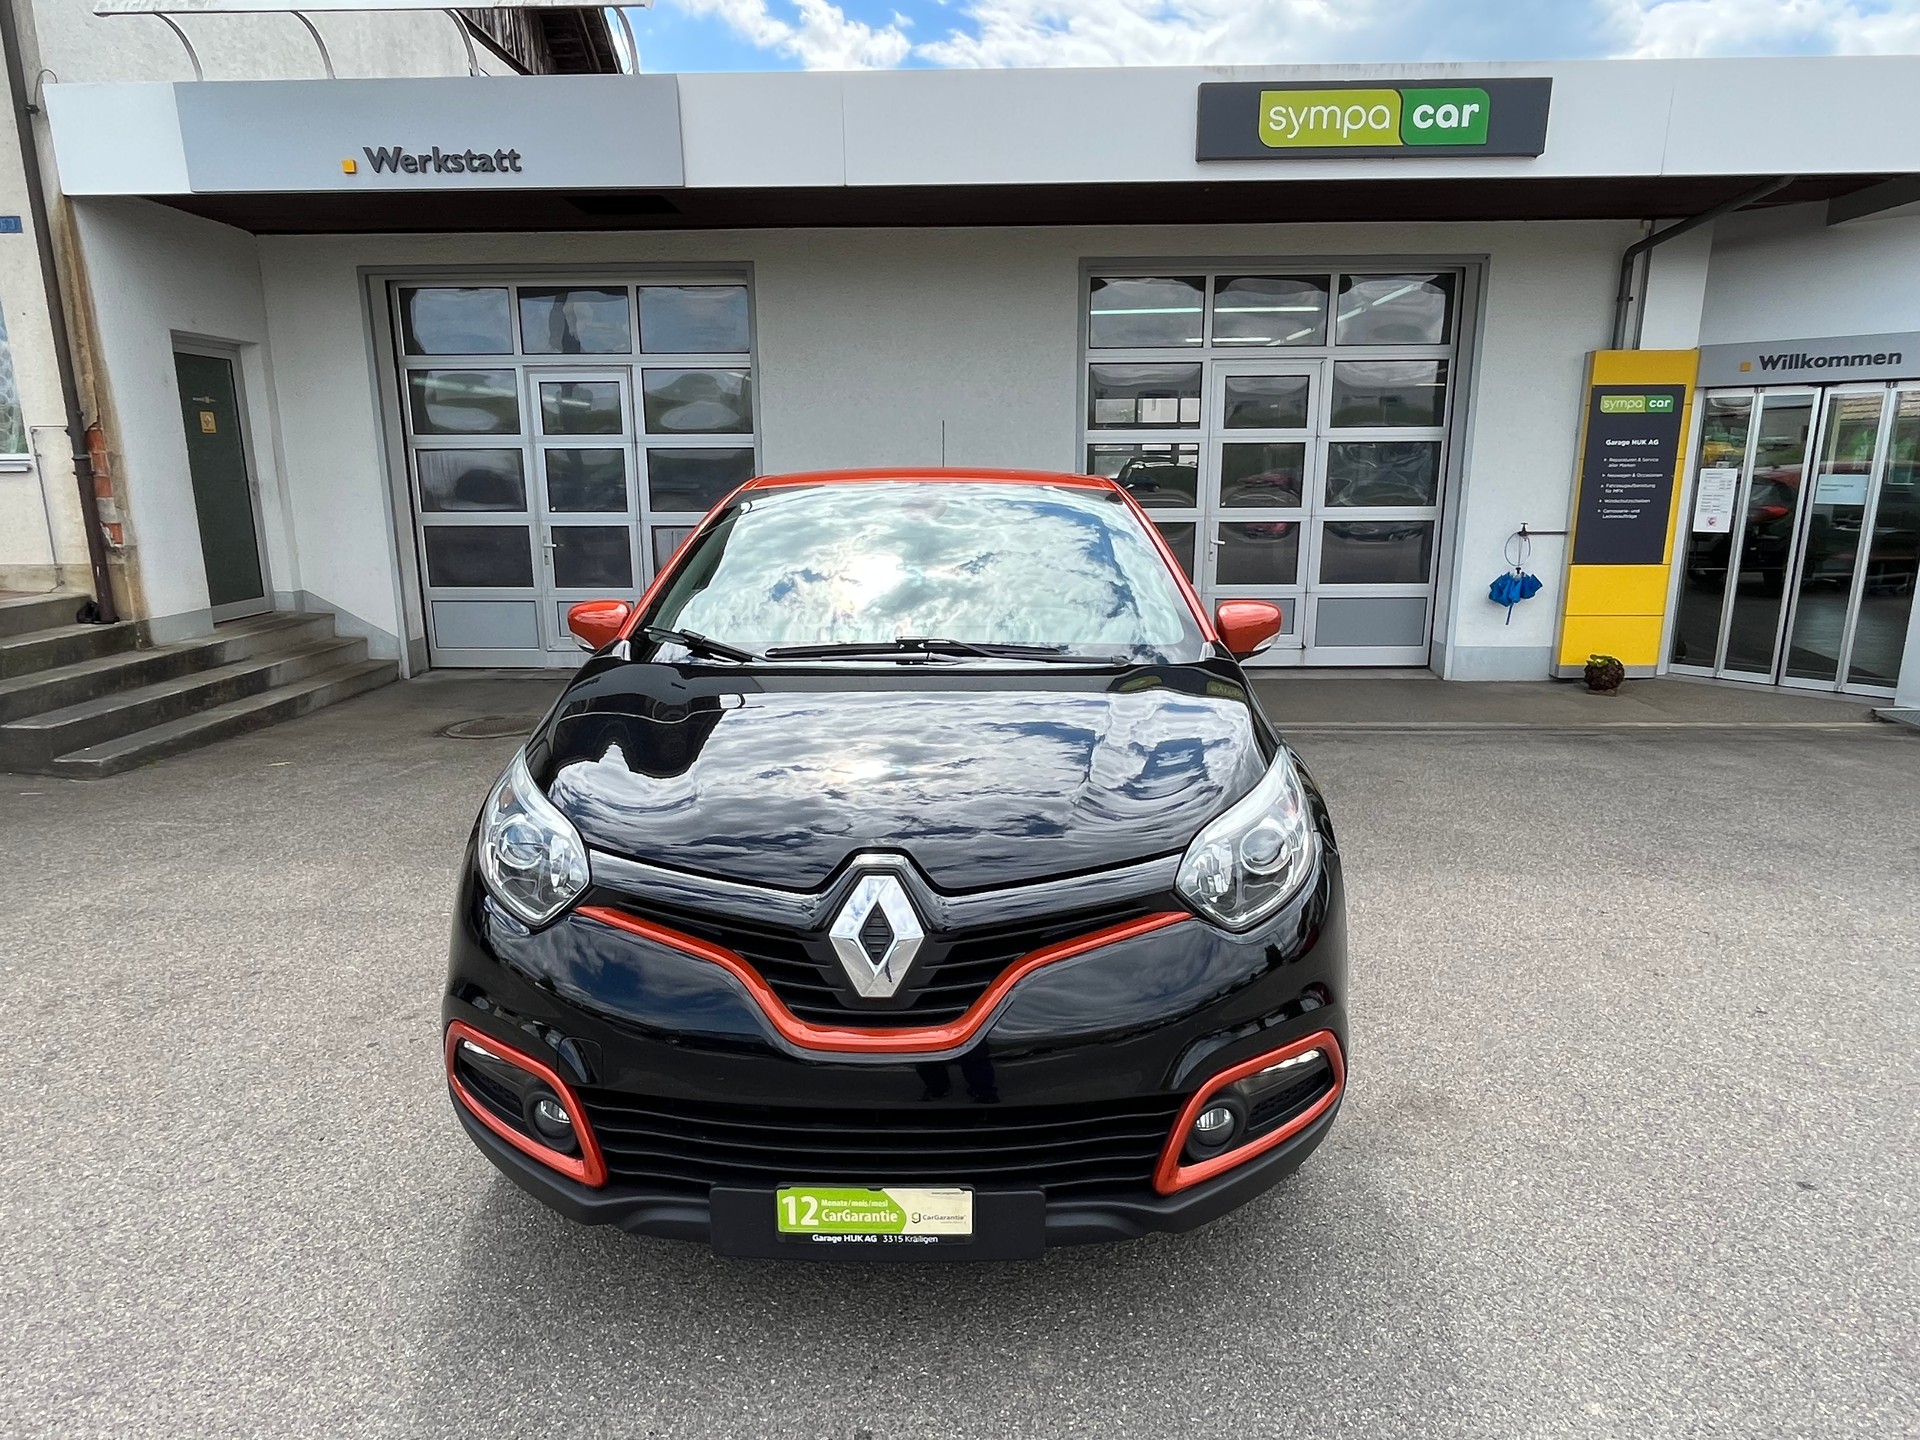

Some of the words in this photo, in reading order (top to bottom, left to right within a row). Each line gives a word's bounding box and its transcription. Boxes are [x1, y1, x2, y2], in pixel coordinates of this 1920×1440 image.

[1268, 104, 1392, 139] sympa
[1412, 103, 1480, 129] car
[362, 145, 523, 174] Werkstatt
[1758, 351, 1903, 371] Willkommen
[1603, 399, 1643, 411] sympa
[1648, 399, 1671, 408] car
[1605, 439, 1631, 447] Garage
[782, 1195, 819, 1226] 12
[812, 1234, 842, 1243] Garage
[843, 1234, 863, 1242] HUK
[864, 1234, 878, 1242] AG
[882, 1235, 904, 1243] 3315
